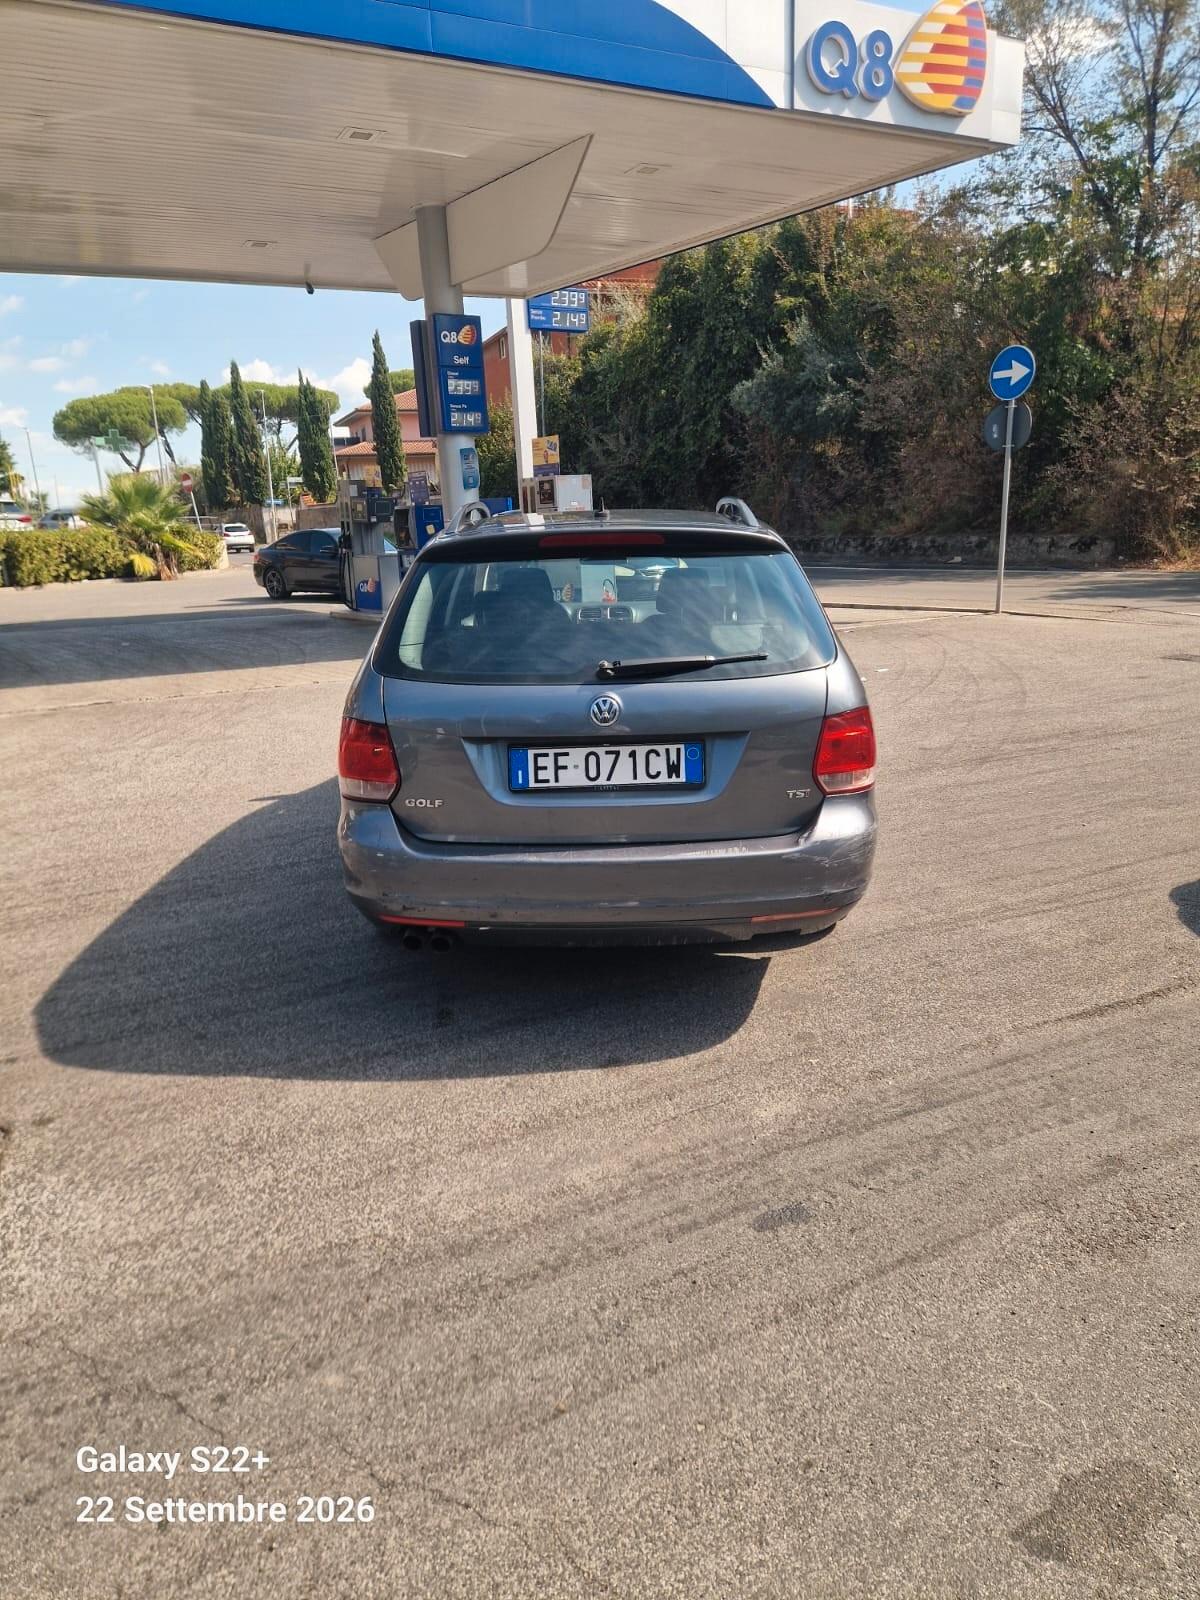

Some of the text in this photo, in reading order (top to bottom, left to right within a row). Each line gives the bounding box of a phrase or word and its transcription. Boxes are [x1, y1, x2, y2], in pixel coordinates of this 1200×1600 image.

[806, 19, 895, 103] Q8
[440, 331, 458, 344] Q8
[453, 355, 469, 365] Self
[591, 697, 620, 727] VW
[405, 798, 443, 808] GOLF
